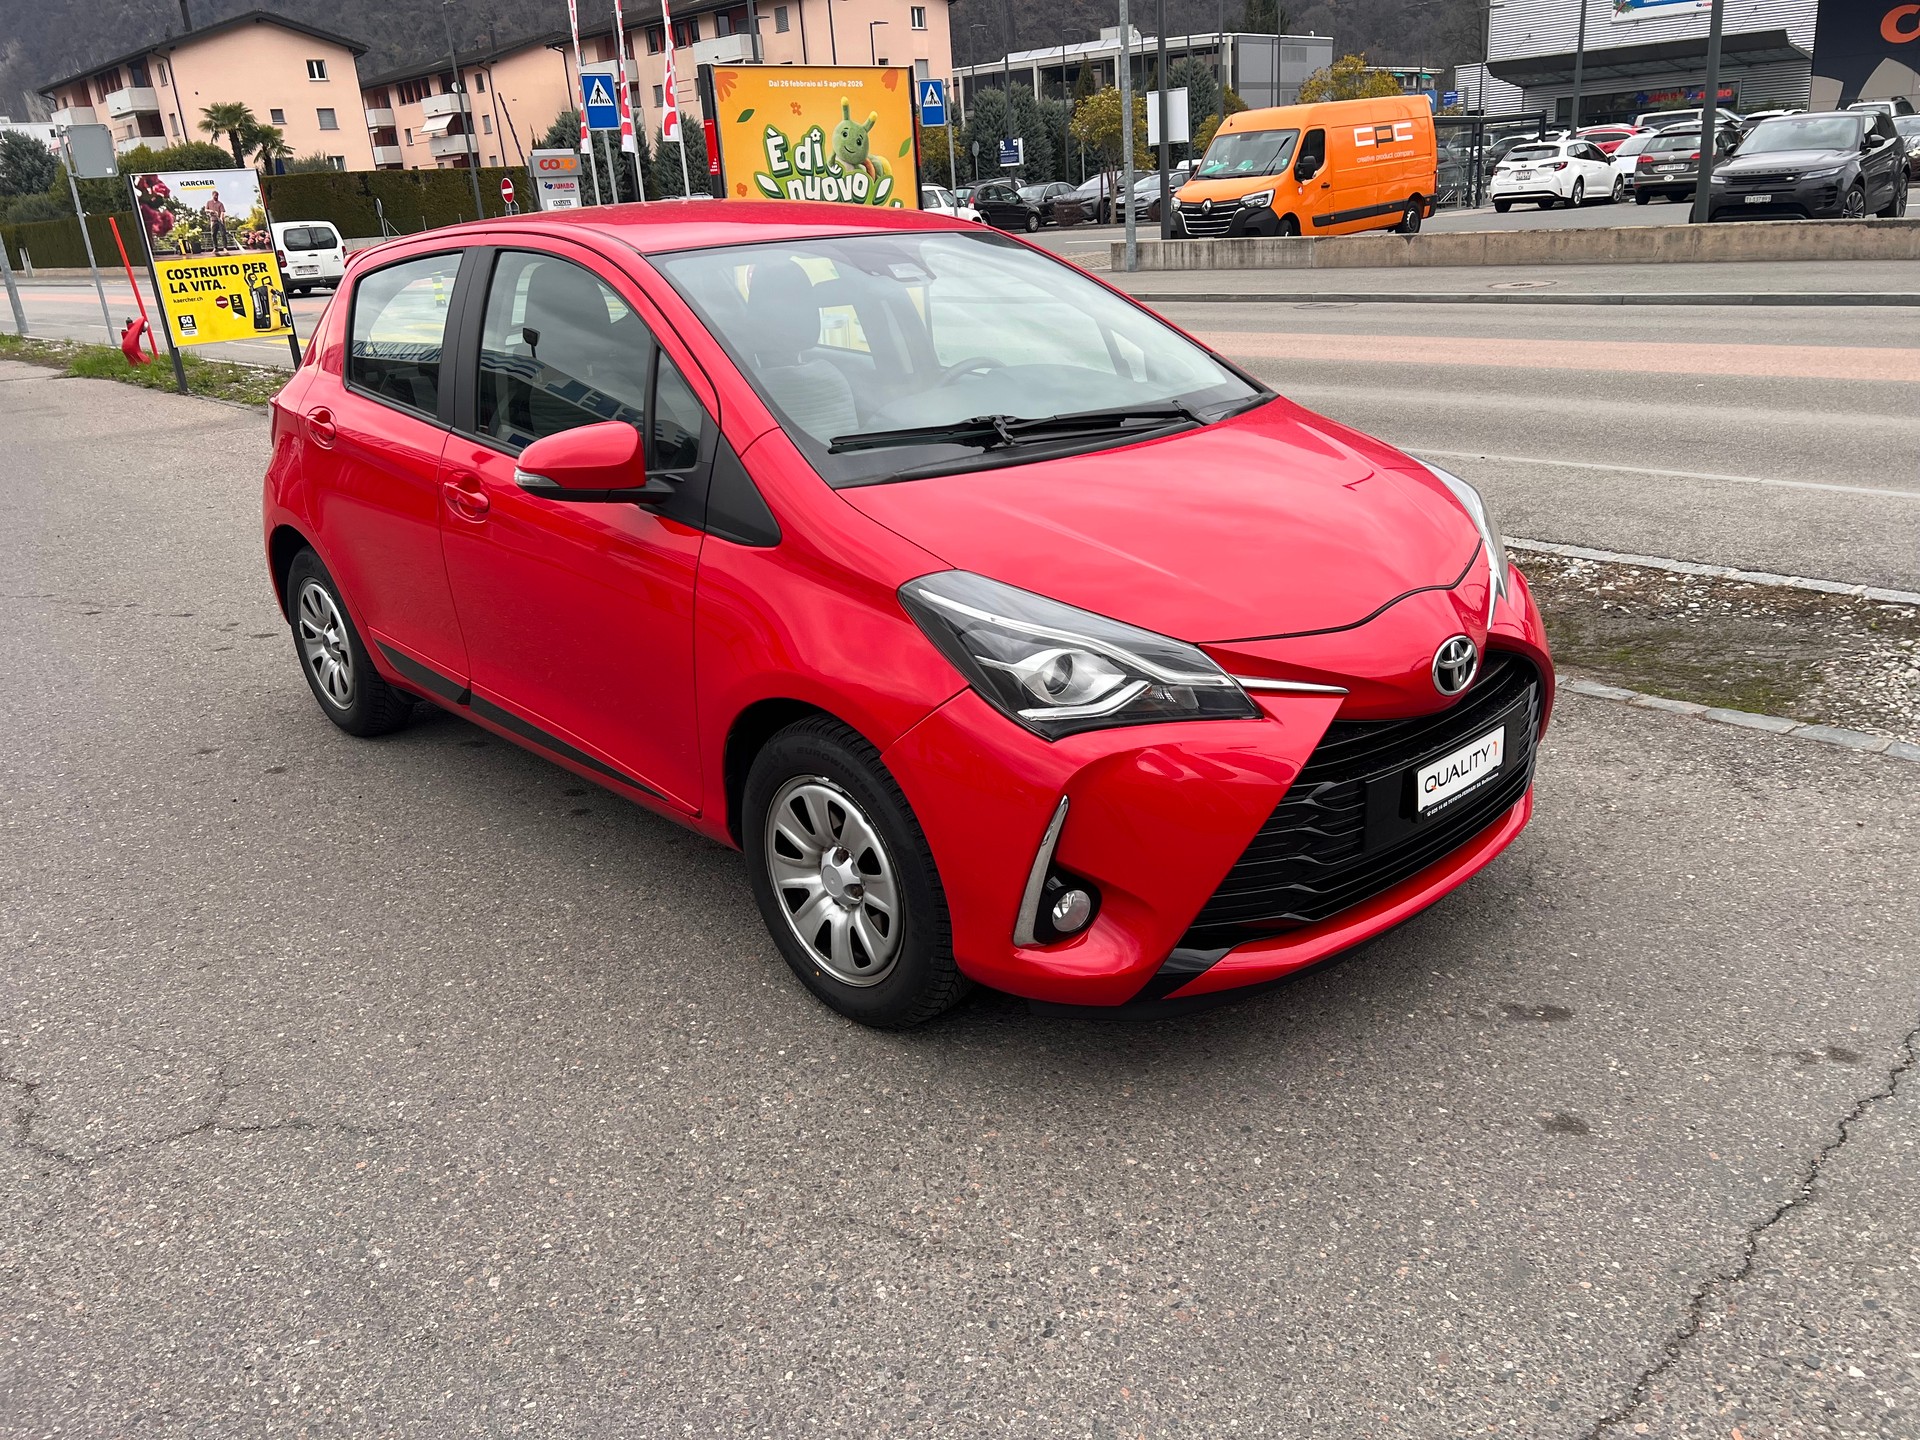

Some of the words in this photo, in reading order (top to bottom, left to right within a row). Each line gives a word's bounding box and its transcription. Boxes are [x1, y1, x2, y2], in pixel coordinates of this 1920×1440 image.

[828, 80, 847, 88] aprile
[766, 127, 790, 173] È
[794, 128, 825, 172] di
[1376, 152, 1394, 161] product
[1394, 150, 1415, 159] company
[553, 182, 575, 190] JUMBO
[786, 172, 870, 202] nuovo
[166, 264, 239, 280] COSTRUITO
[242, 262, 268, 274] PER
[169, 281, 189, 294] LA
[190, 280, 226, 292] VITA.
[173, 296, 204, 304] kaercher.ch
[232, 295, 240, 303] 5
[181, 316, 193, 324] 60
